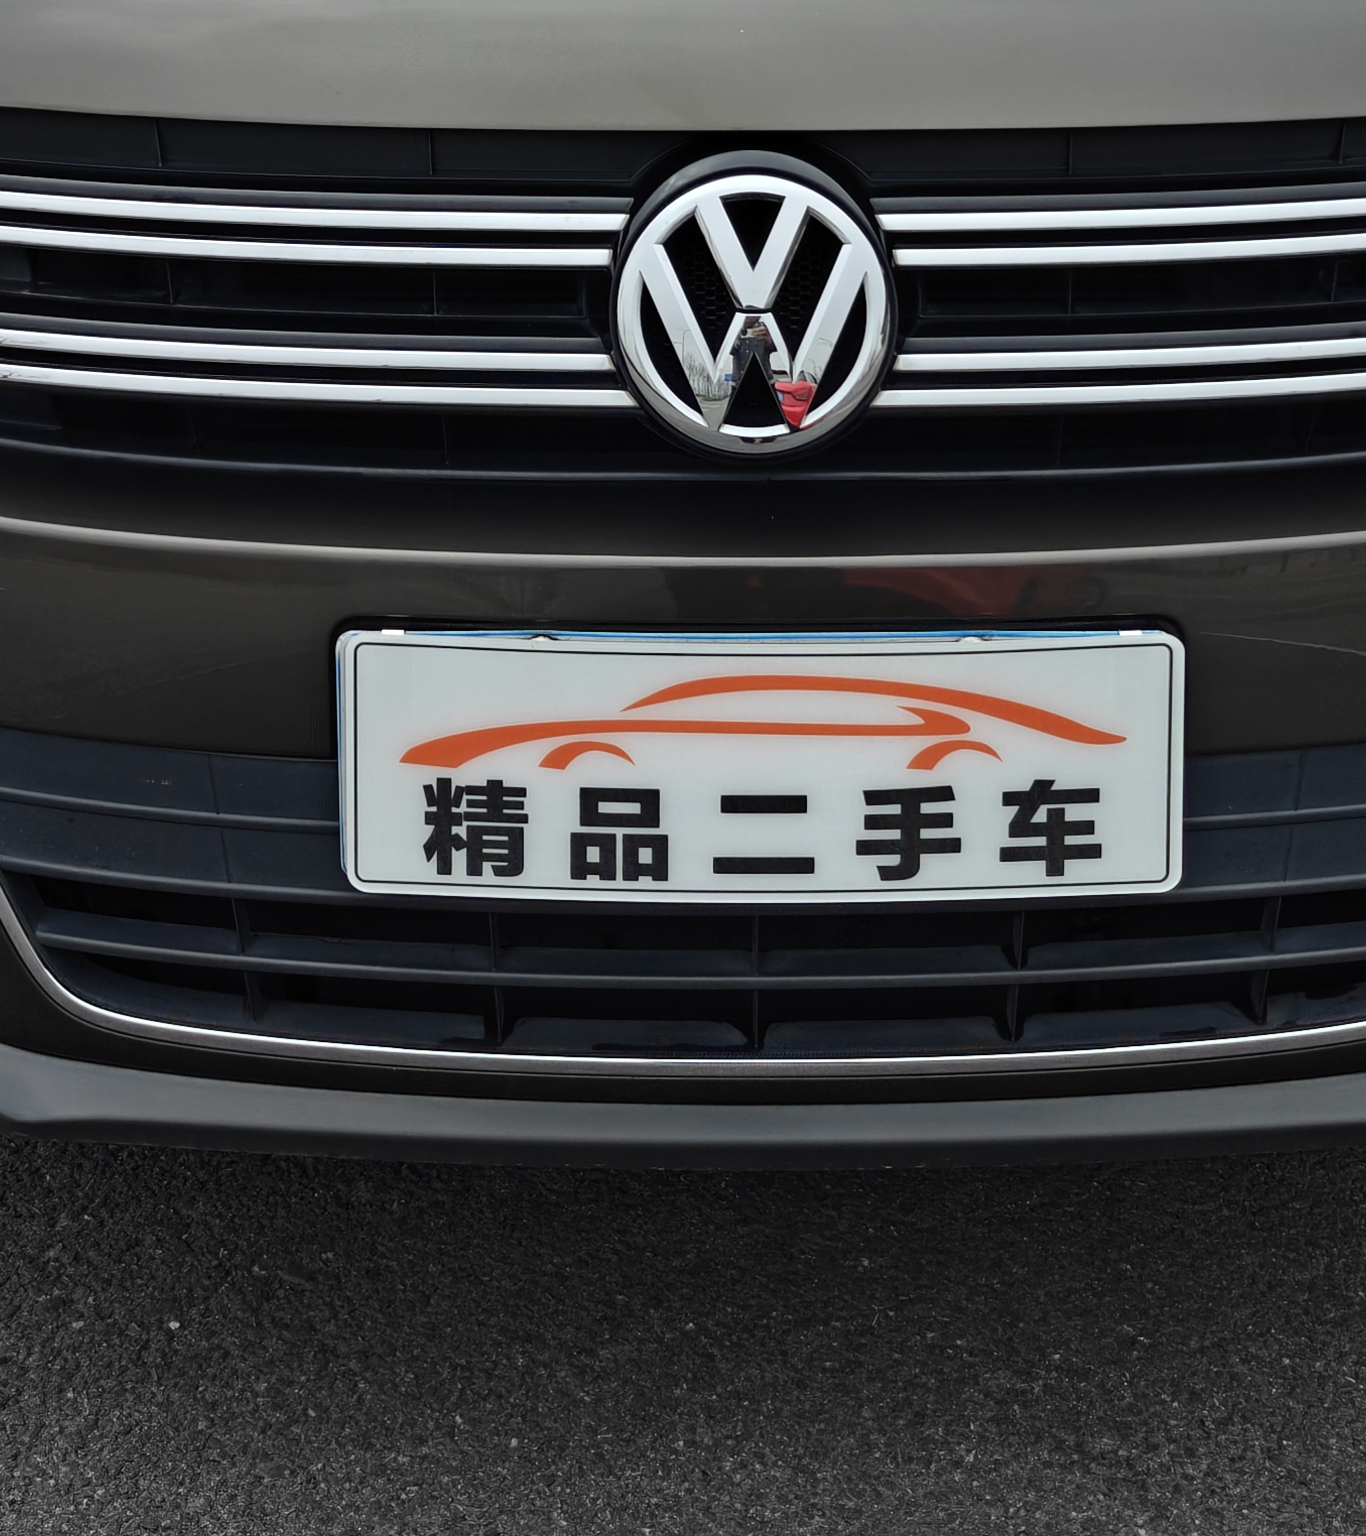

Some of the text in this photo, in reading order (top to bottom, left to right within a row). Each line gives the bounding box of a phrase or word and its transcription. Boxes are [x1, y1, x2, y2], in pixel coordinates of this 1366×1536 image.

[422, 777, 1103, 882] 精品二手车
